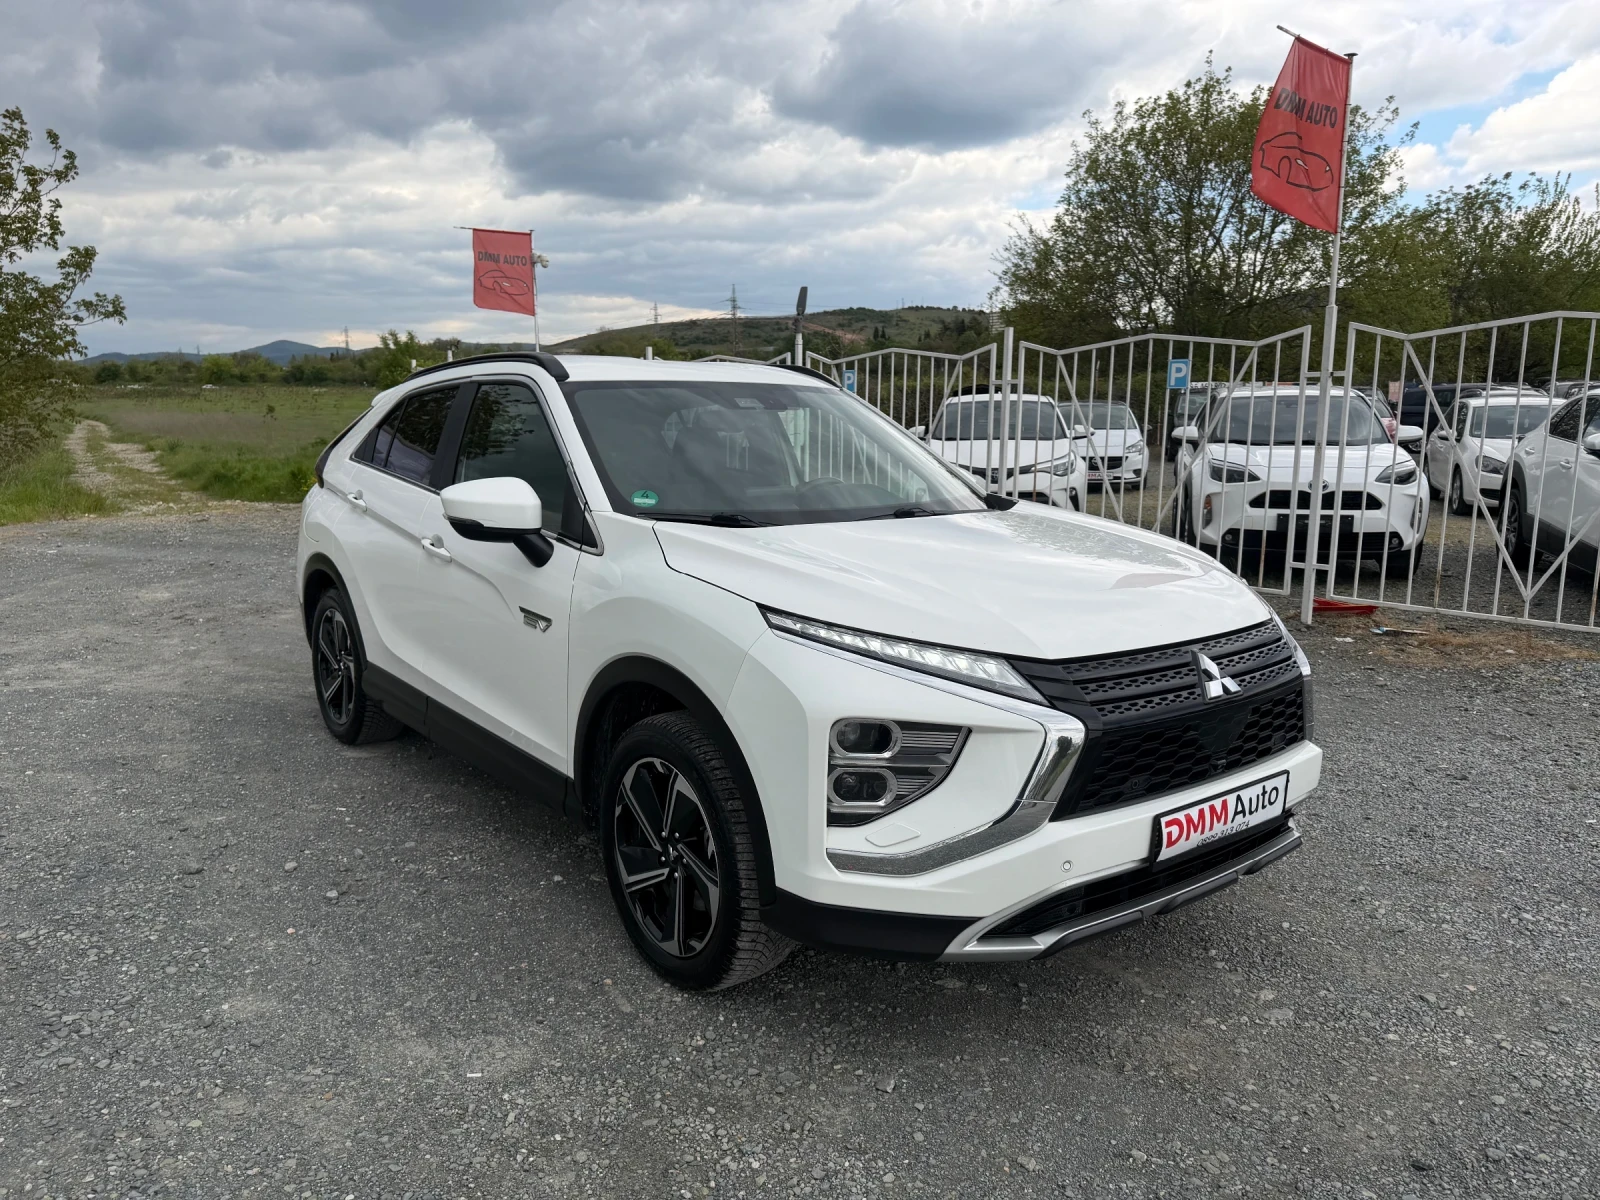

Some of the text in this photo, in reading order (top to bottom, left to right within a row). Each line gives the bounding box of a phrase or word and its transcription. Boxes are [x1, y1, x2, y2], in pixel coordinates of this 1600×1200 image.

[1305, 101, 1338, 128] AUTO
[503, 254, 528, 267] AUTO
[845, 372, 854, 390] P
[1169, 363, 1188, 386] P
[641, 490, 649, 499] 4
[1164, 784, 1279, 849] DMM Auto
